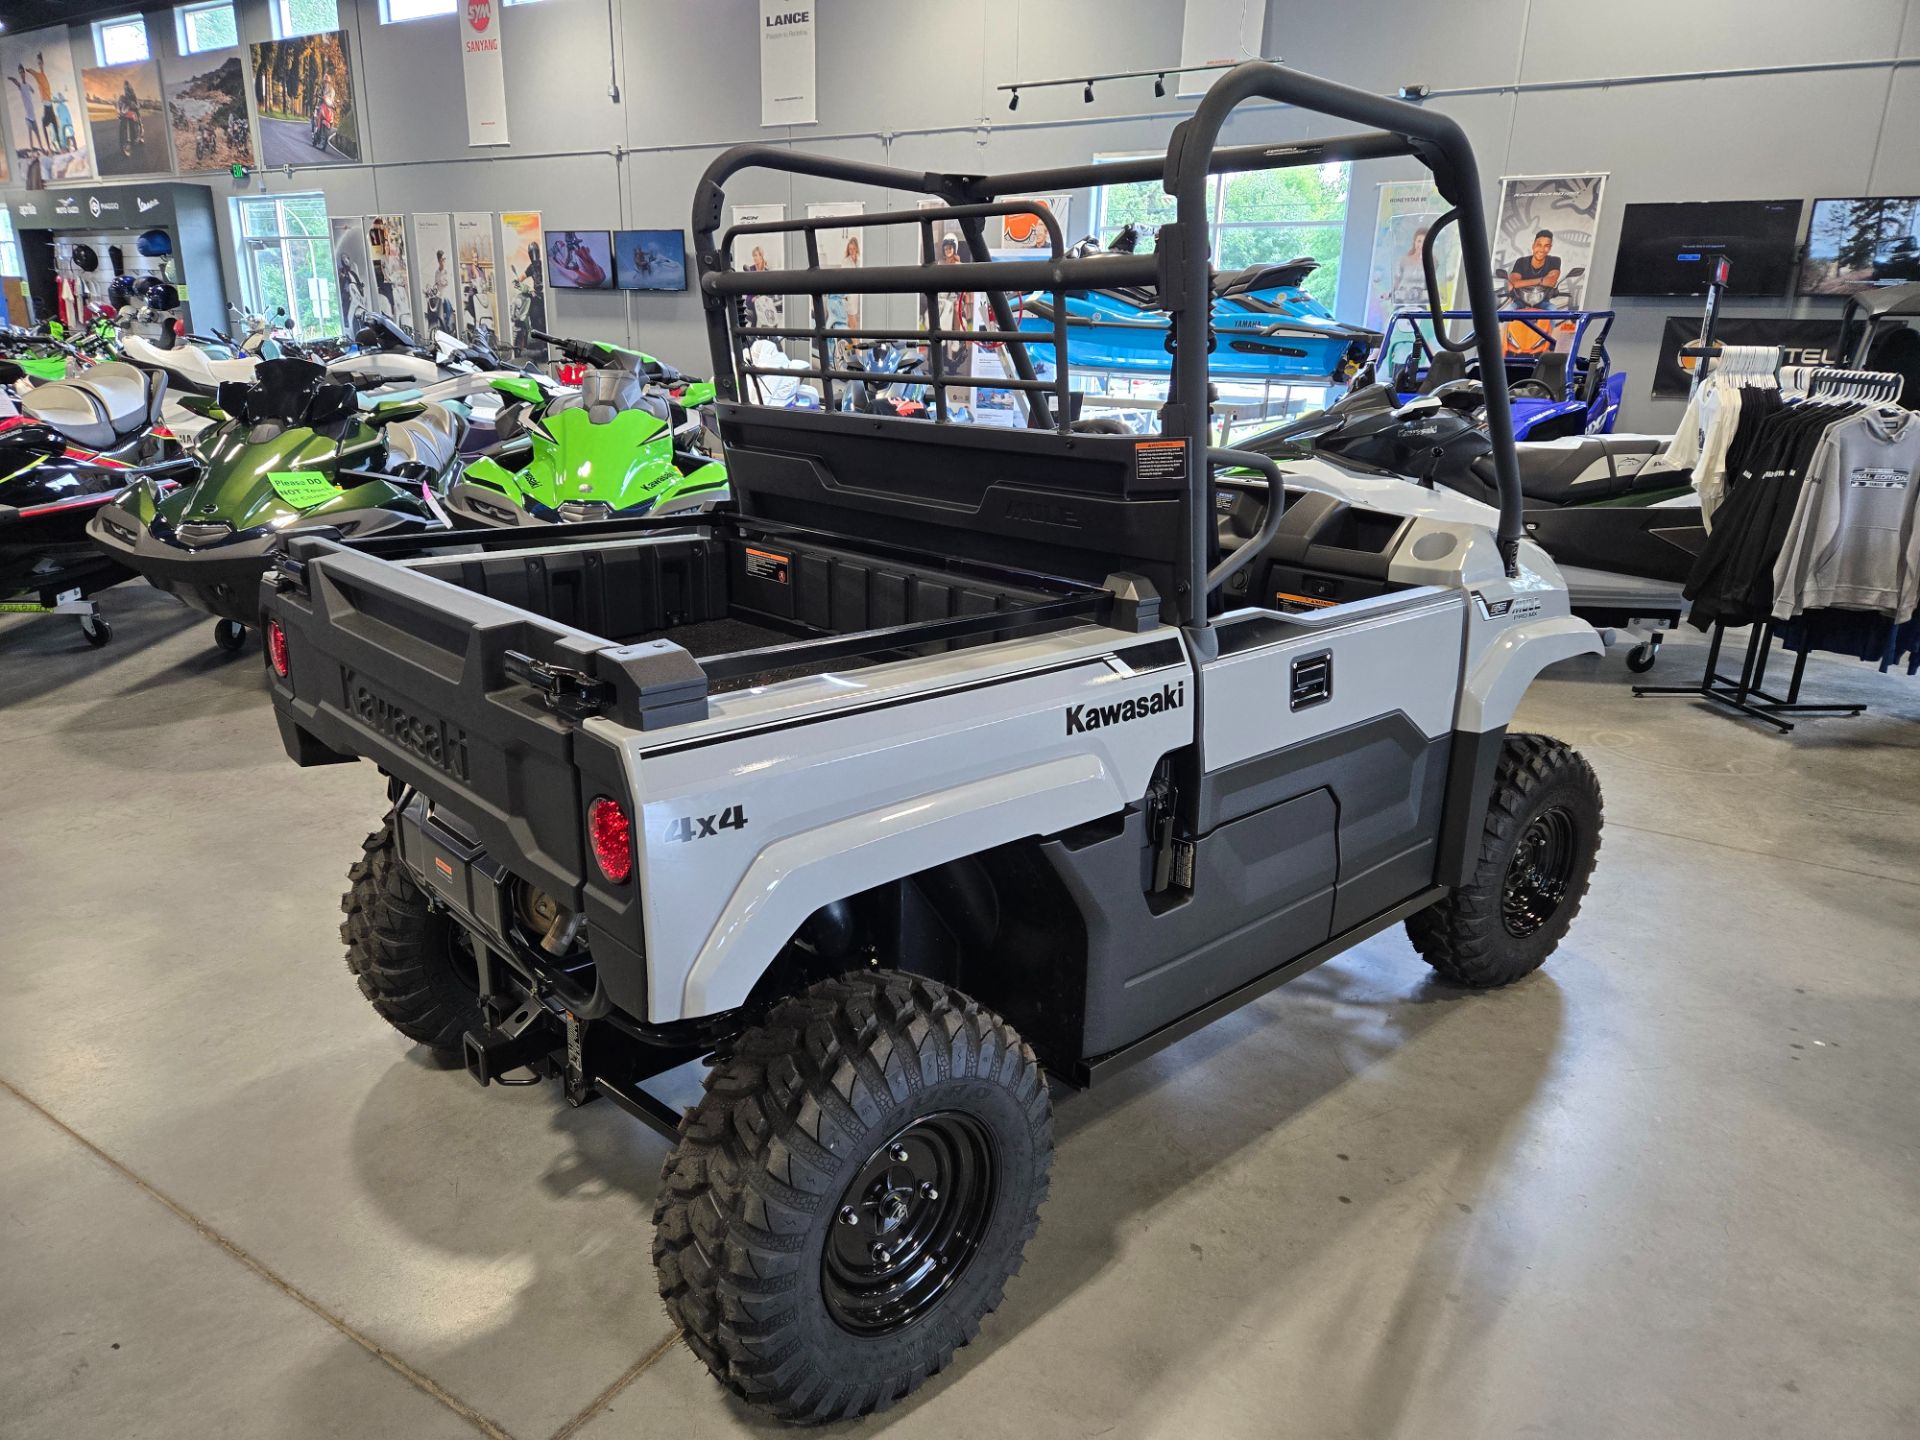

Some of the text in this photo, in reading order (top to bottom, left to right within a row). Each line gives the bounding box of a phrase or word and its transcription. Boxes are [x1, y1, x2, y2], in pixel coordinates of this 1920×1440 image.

[468, 4, 490, 23] SYM
[766, 11, 809, 27] LANCE
[466, 39, 498, 52] SANYANG
[1234, 320, 1261, 328] YAMAHA
[1397, 425, 1438, 438] Kawasaki
[274, 479, 306, 487] Please
[640, 471, 675, 492] Kawasaki
[279, 488, 301, 496] NOT
[1066, 680, 1184, 737] Kawasaki
[340, 663, 470, 783] Kawasaki
[664, 804, 749, 843] 4x4
